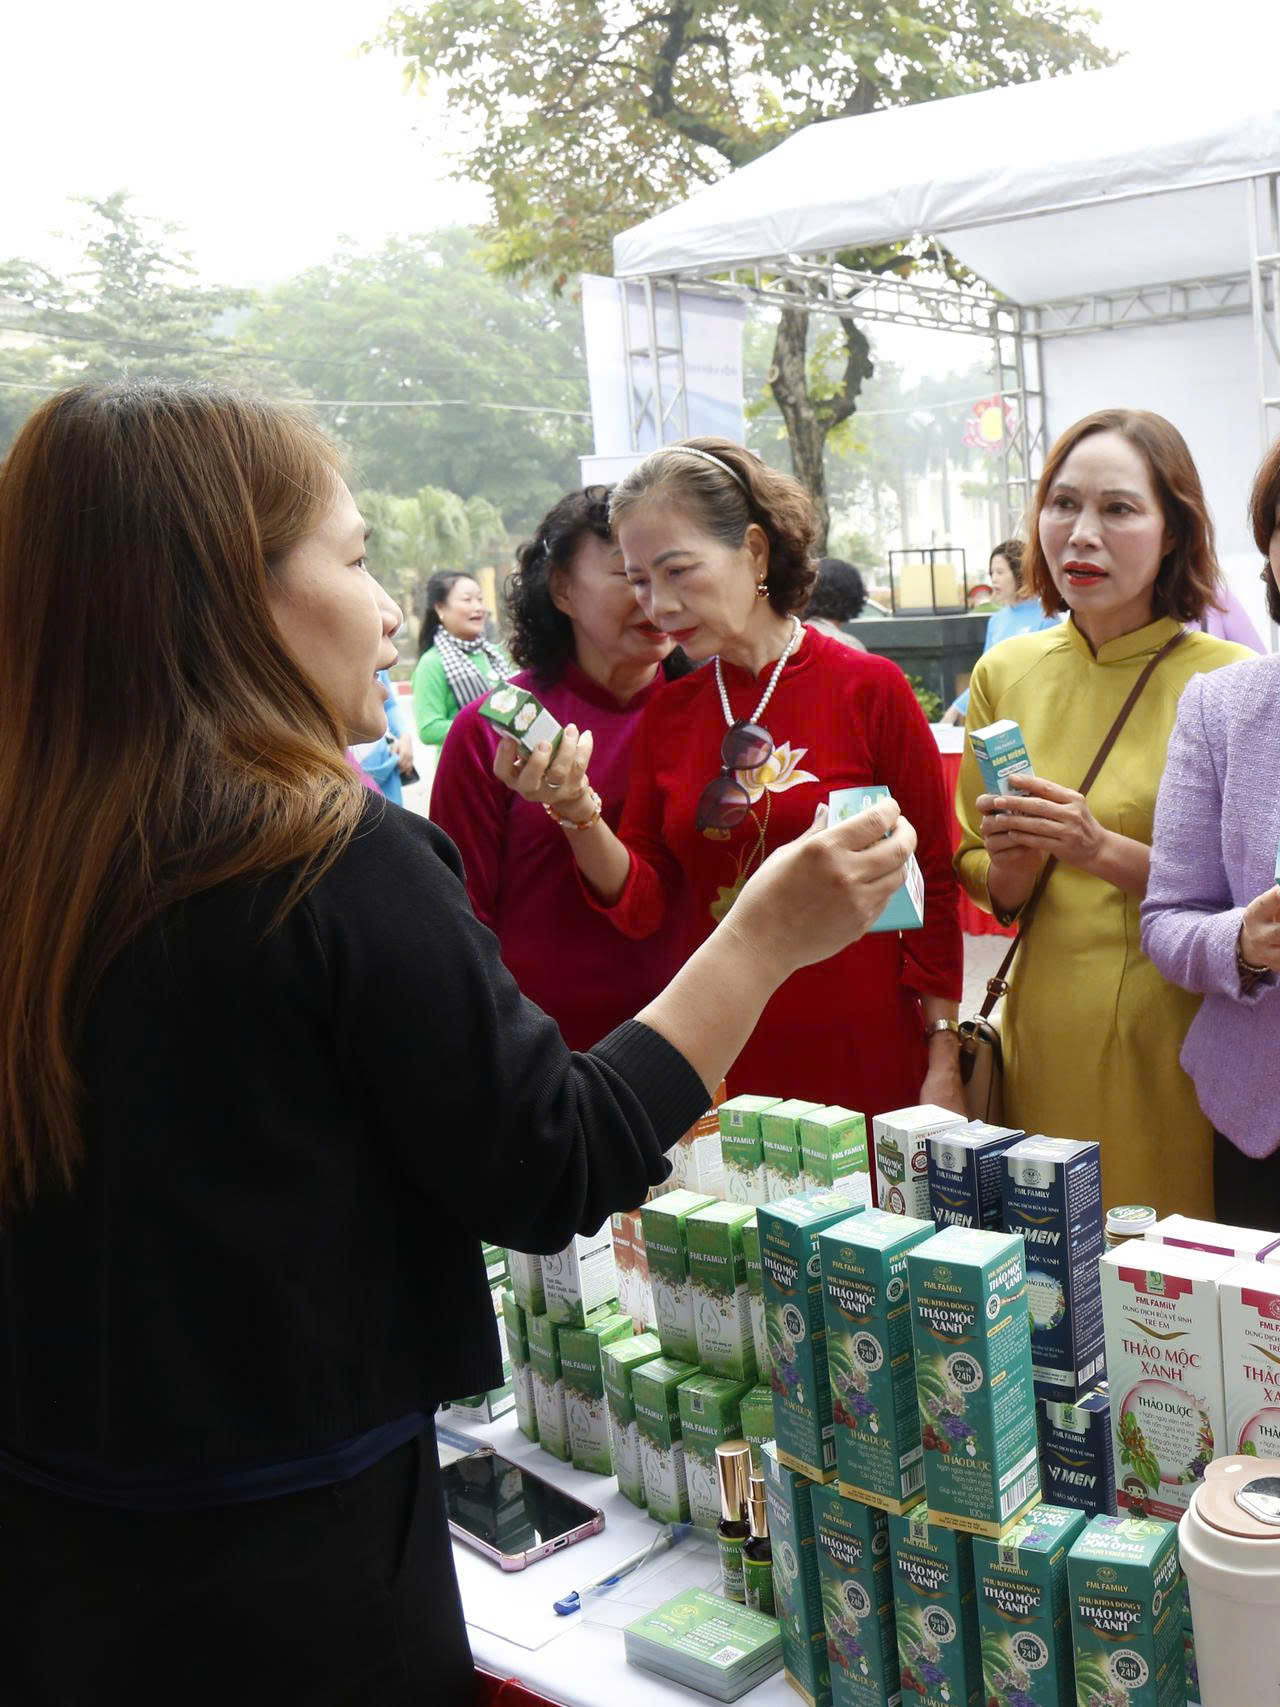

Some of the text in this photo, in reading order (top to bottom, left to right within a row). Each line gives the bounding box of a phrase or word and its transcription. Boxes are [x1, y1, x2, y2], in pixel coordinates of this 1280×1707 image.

[943, 1208, 973, 1228] MEN
[1025, 1227, 1061, 1247] MEN
[690, 1252, 702, 1261] FML
[924, 1281, 937, 1290] FML
[840, 1298, 866, 1314] XANH
[1136, 1296, 1149, 1305] FML
[1123, 1305, 1139, 1314] DUNG
[949, 1311, 975, 1325] MỘC
[1159, 1321, 1170, 1329] EM
[932, 1319, 963, 1334] XANH
[1260, 1321, 1274, 1330] FML
[1245, 1329, 1263, 1339] DUNG
[1121, 1339, 1200, 1368] THẢO MỘC
[956, 1371, 972, 1382] 24h
[1141, 1360, 1182, 1381] XANH
[1137, 1396, 1193, 1418] THẢO DƯỢC
[1062, 1468, 1097, 1489] MEN
[830, 1547, 853, 1564] XANH
[910, 1573, 937, 1589] XANH
[1087, 1581, 1100, 1589] FML
[997, 1599, 1028, 1614] XANH
[1016, 1593, 1040, 1607] MỘC
[1114, 1610, 1141, 1623] MỘC
[1095, 1618, 1128, 1632] XANH
[1022, 1649, 1037, 1660] 24h
[1121, 1668, 1136, 1678] 24h
